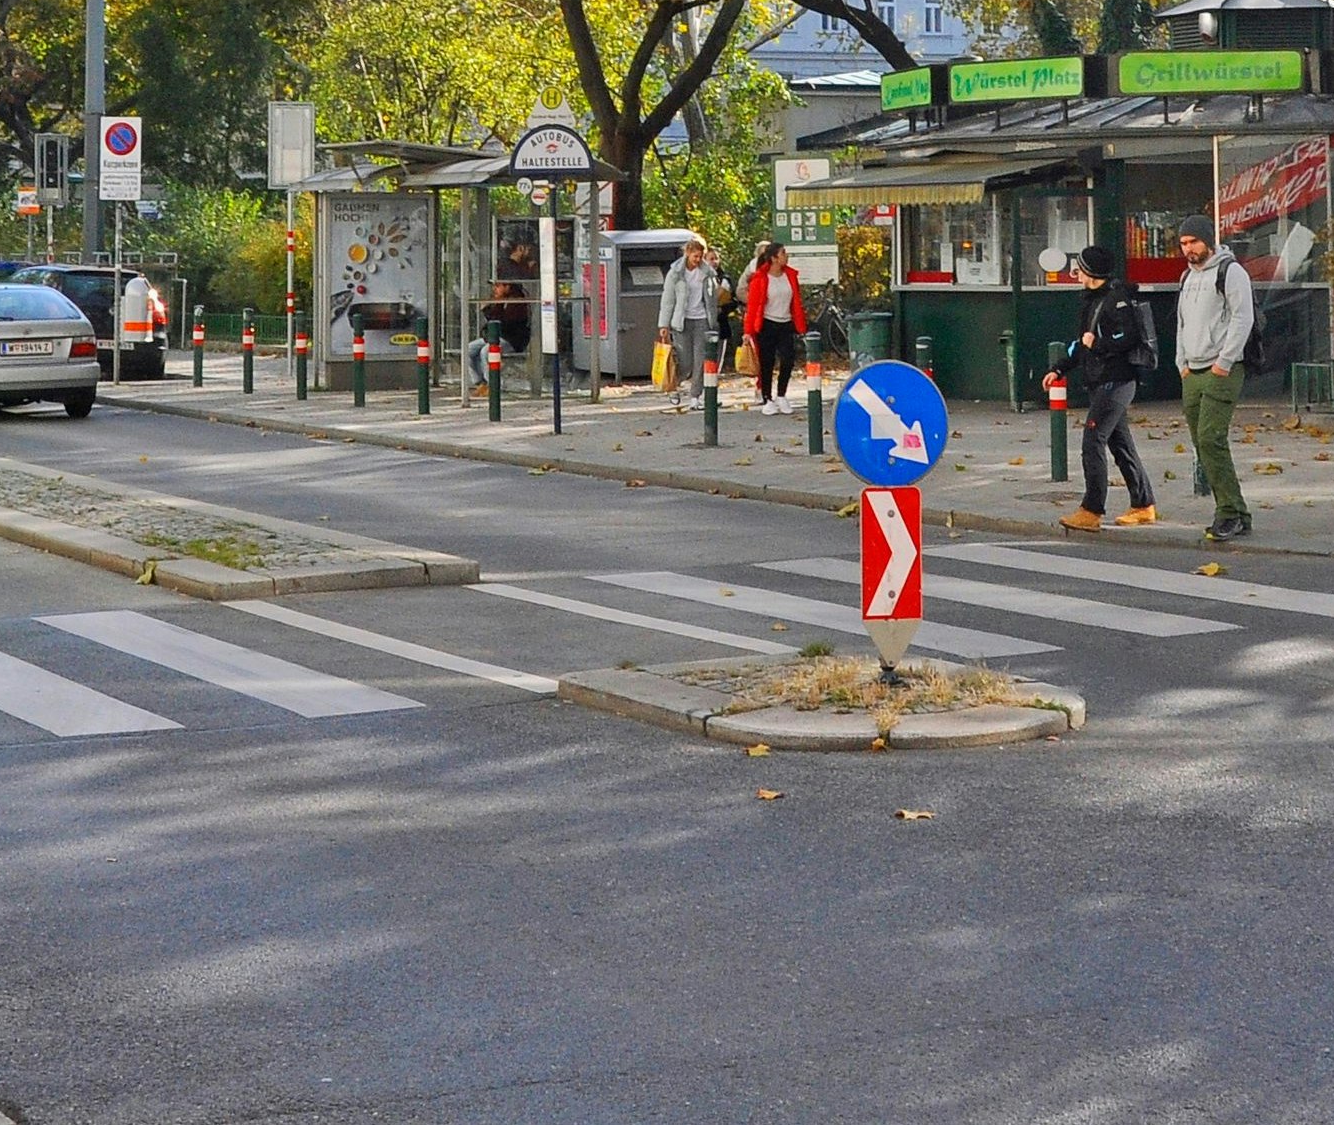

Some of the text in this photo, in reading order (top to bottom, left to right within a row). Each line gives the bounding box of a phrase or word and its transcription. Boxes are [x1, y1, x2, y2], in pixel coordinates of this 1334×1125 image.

[953, 69, 1027, 97] Würstel
[1030, 67, 1081, 93] Platz
[1135, 61, 1283, 89] Grillwürstel
[546, 91, 558, 105] H
[530, 131, 575, 149] AUTOBUS
[521, 156, 583, 167] HALTESTELLE
